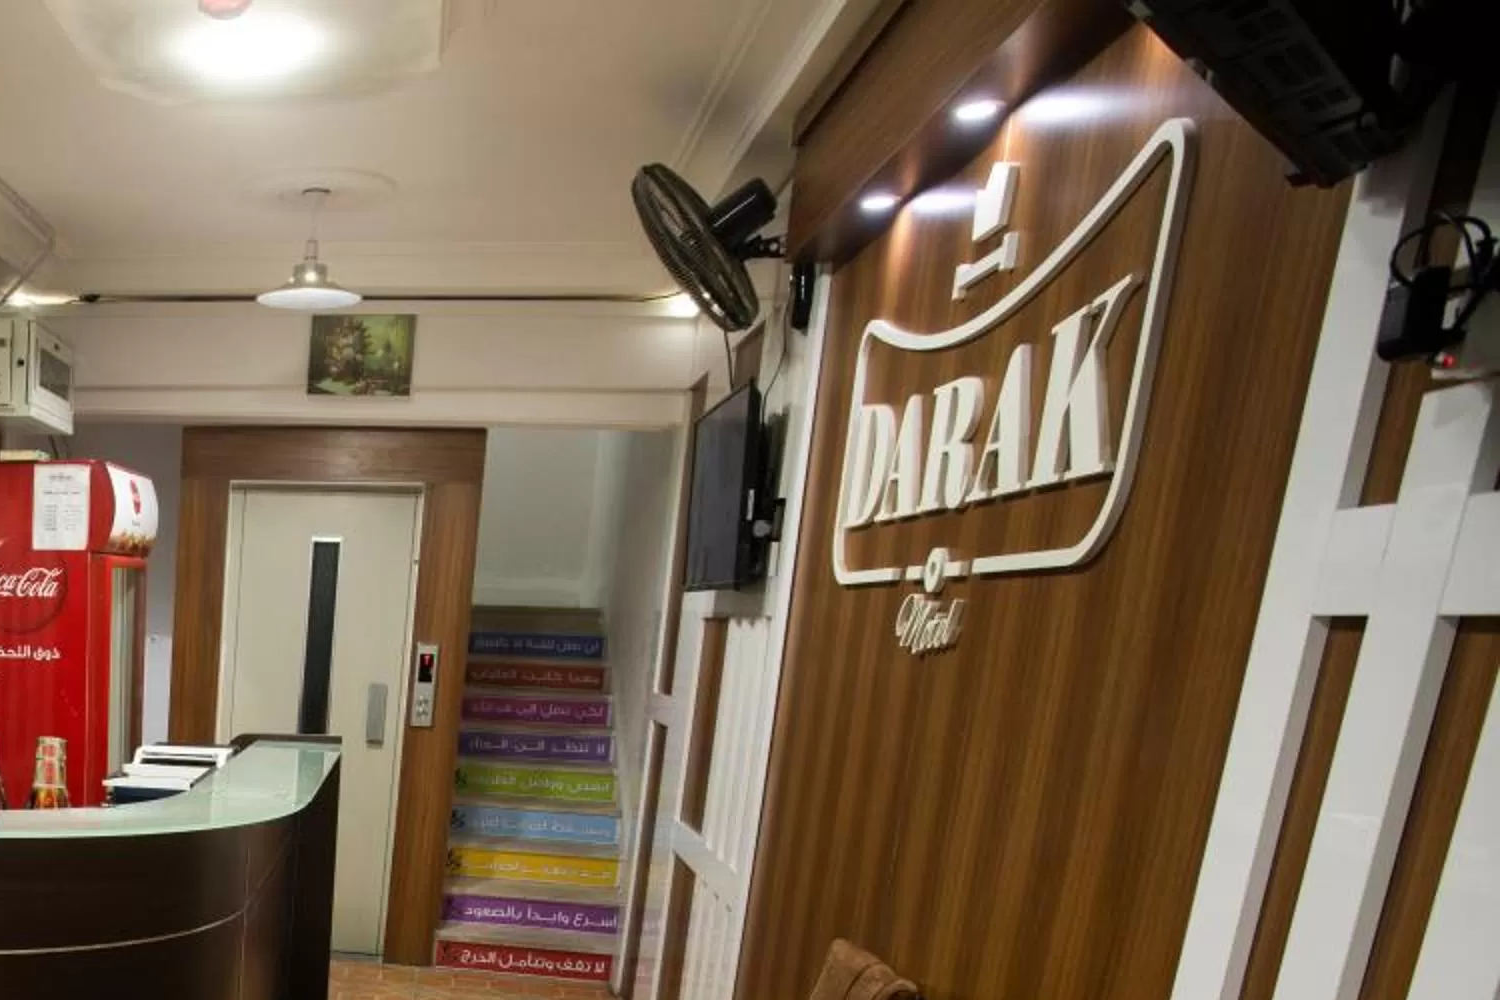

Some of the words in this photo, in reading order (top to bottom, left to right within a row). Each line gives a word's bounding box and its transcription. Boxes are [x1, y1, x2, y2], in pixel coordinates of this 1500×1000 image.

[842, 272, 1140, 529] DARAK
[33, 645, 61, 661] ذوق
[464, 905, 523, 921] بالصعود
[460, 949, 497, 964] الدرج
[556, 957, 591, 972] تقف
[594, 960, 605, 973] لا
